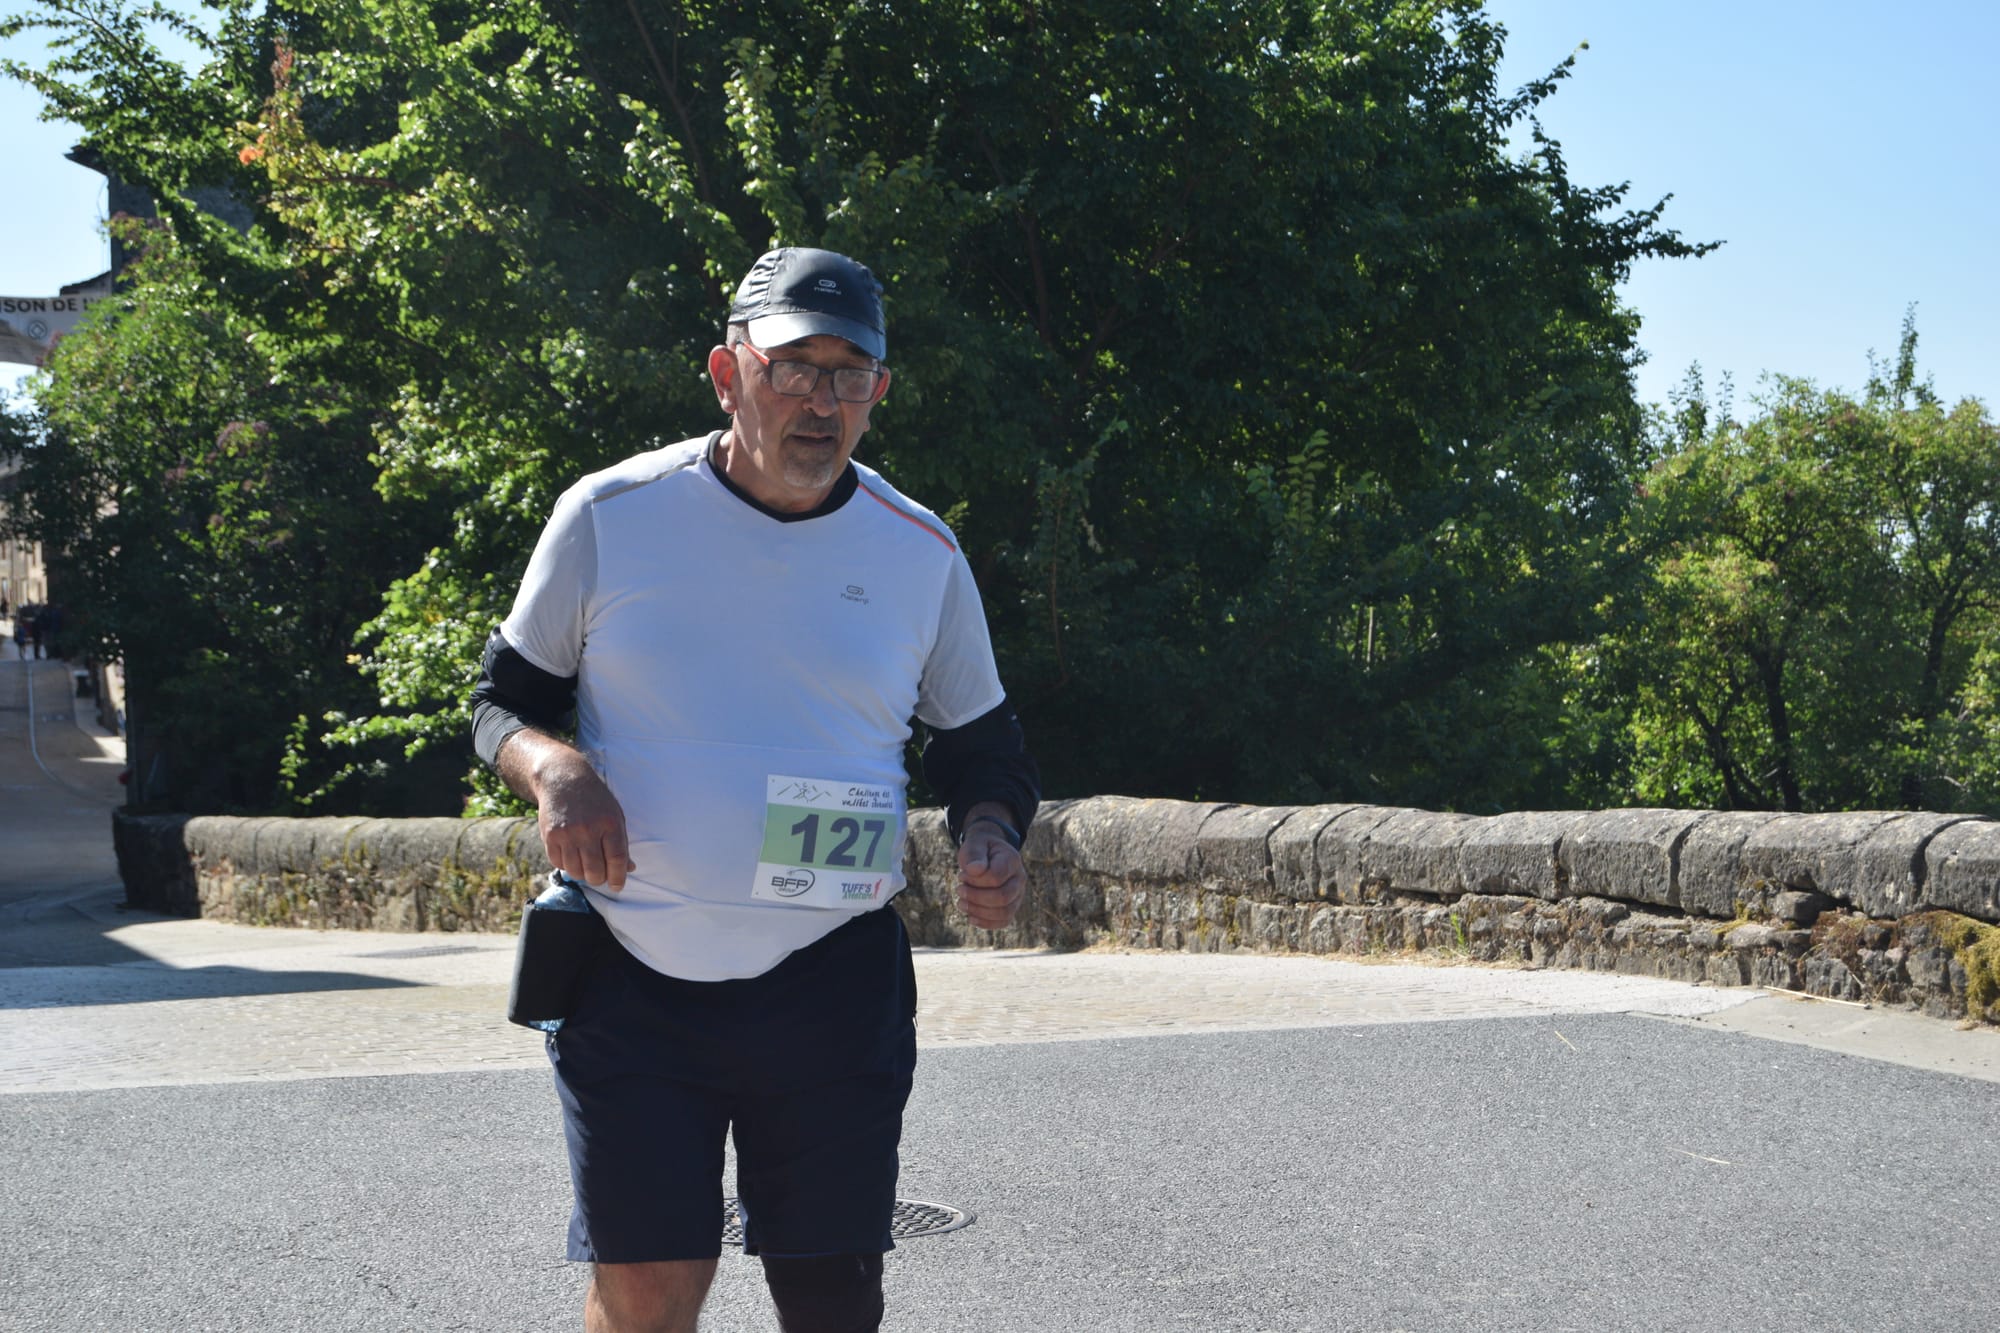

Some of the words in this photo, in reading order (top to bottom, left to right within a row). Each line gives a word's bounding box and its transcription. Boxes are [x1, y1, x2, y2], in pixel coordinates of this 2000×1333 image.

[52, 298, 78, 312] DE
[791, 813, 885, 867] 127
[771, 876, 808, 889] BFP
[841, 882, 872, 893] TUFF'S
